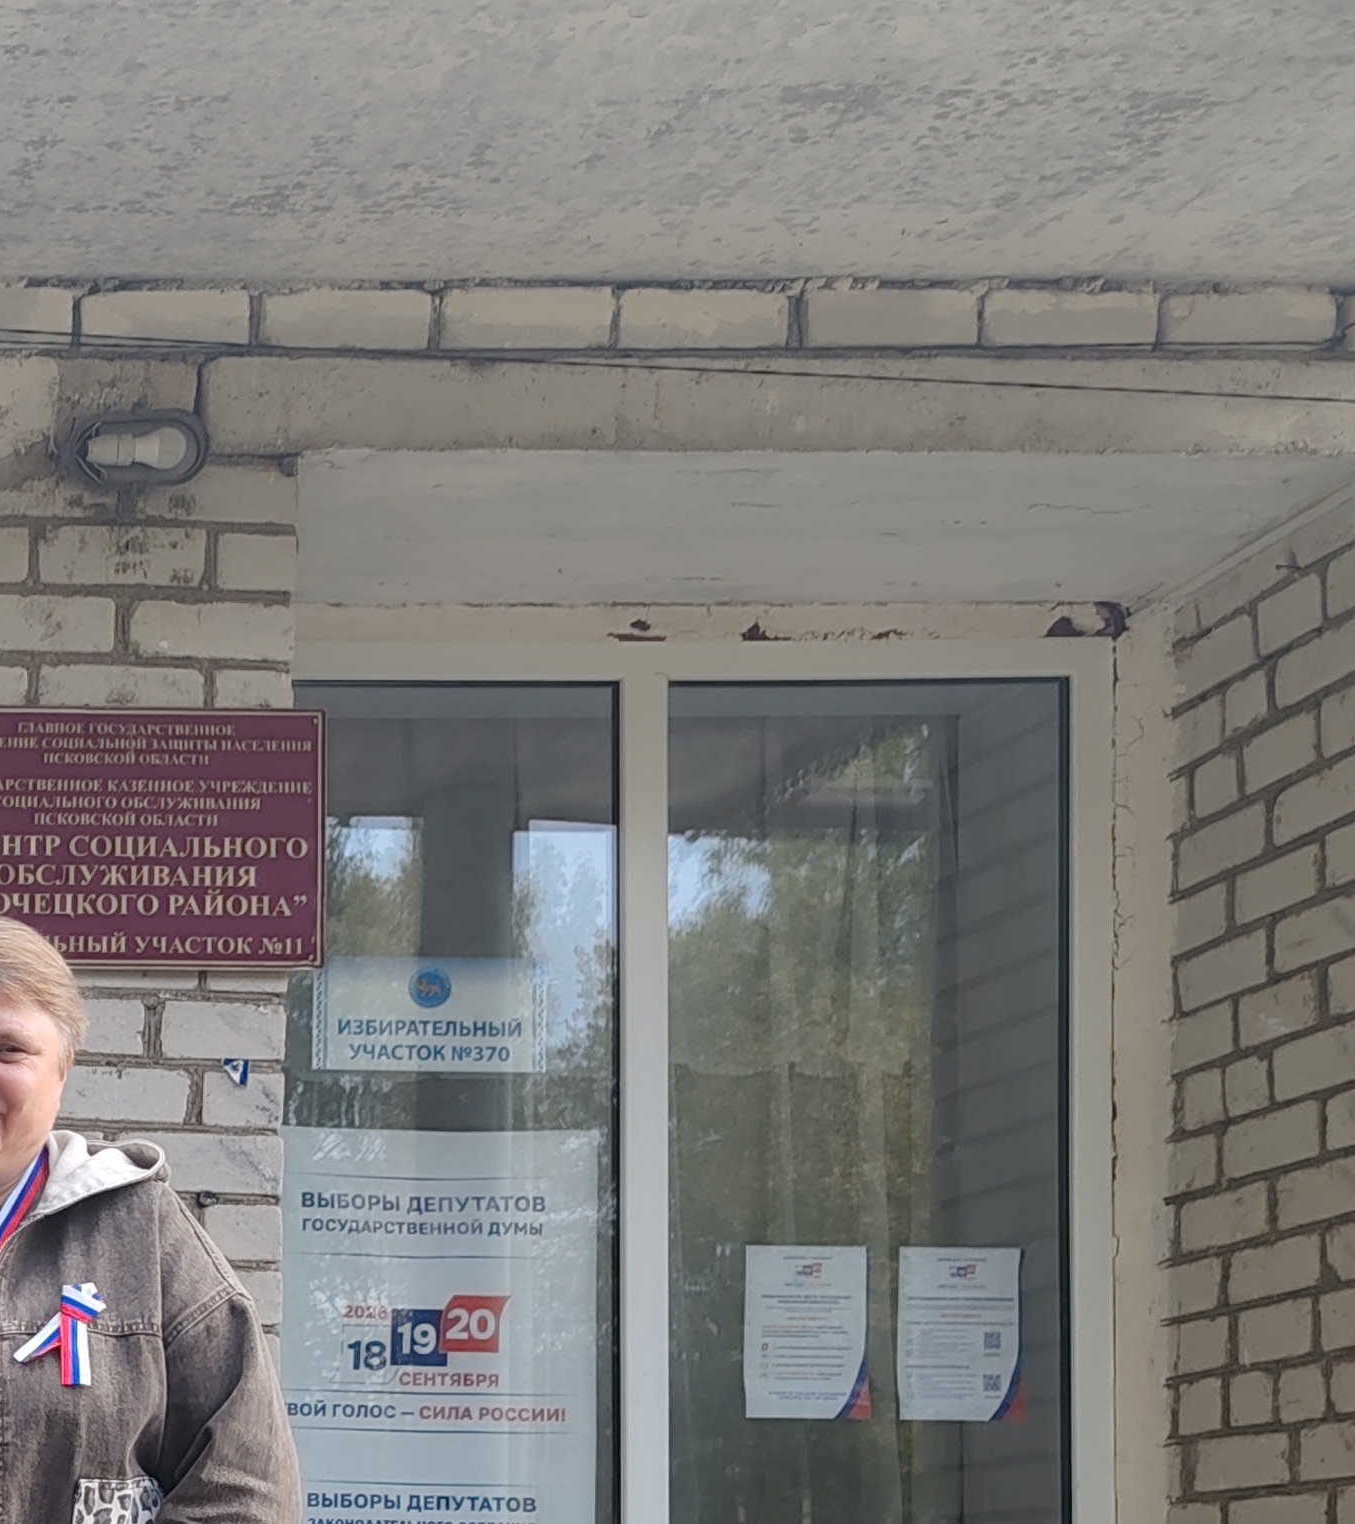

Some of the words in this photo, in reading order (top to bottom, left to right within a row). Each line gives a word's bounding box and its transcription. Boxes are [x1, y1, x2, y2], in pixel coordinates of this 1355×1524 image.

[17, 722, 85, 734] ГЛАВНОЕ
[89, 722, 235, 737] ГОСУДАРСТВЕННОЕ
[42, 735, 147, 751] СОЦИАЛЬНОЙ
[152, 739, 217, 752] ЗАЩИТЫ
[221, 739, 312, 752] НАСЕЛЕНИЯ
[43, 751, 135, 765] ПСКОВСКОЙ
[139, 754, 210, 766] ОБЛАСТИ
[107, 779, 195, 793] КАЗЕННОЕ
[199, 780, 313, 795] УЧРЕЖДЕНИЕ
[121, 797, 261, 811] ОБСЛУЖИВАНИЯ
[34, 811, 136, 826] ПСКОВСКОЙ
[140, 813, 219, 827] ОБЛАСТИ
[69, 835, 309, 861] СОЦИАЛЬНОГО
[134, 935, 254, 955] УЧАСТОК
[258, 937, 304, 956] №11
[337, 1017, 523, 1038] ИЗБИРАТЕЛЬНЫЙ
[349, 1043, 446, 1062] УЧАСТОК
[451, 1045, 511, 1063] №370
[301, 1191, 400, 1212] ВЫБОРЫ
[406, 1195, 547, 1216] ДЕПУТАТОВ
[301, 1217, 484, 1236] ГОСУДАРСТВЕННОЙ
[487, 1221, 544, 1237] ДУМЫ
[347, 1340, 387, 1371] 18
[397, 1322, 437, 1355] 19
[445, 1308, 496, 1341] 20
[398, 1372, 500, 1388] СЕНТЯБРЯ
[332, 1403, 396, 1419] ГОЛОС
[419, 1405, 473, 1421] СИЛА
[478, 1406, 566, 1422] РОССИИ!
[306, 1492, 402, 1510] ВЫБОРЫ
[406, 1495, 538, 1514] ДЕПУТАТОВ
